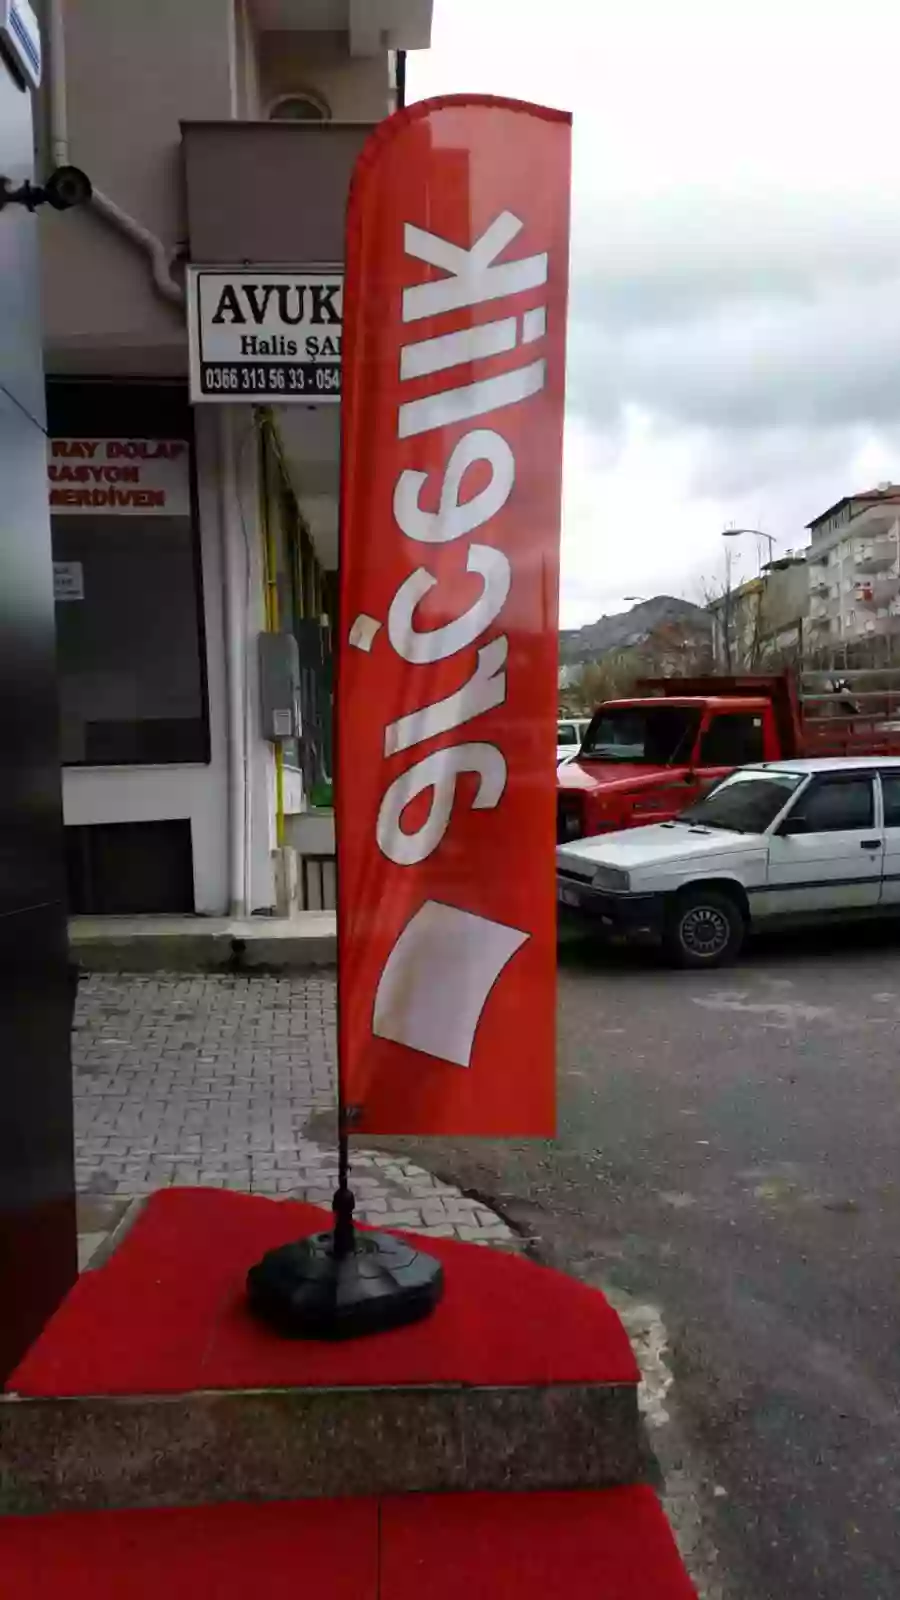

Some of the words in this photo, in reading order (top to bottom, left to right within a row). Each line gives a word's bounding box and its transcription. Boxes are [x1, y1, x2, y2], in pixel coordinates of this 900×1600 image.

[211, 284, 343, 325] AVUK
[240, 335, 298, 356] Halis
[205, 368, 238, 389] 0366
[241, 368, 266, 389] 313
[269, 368, 285, 389] 56
[289, 368, 305, 389] 33
[51, 440, 100, 458] RAY
